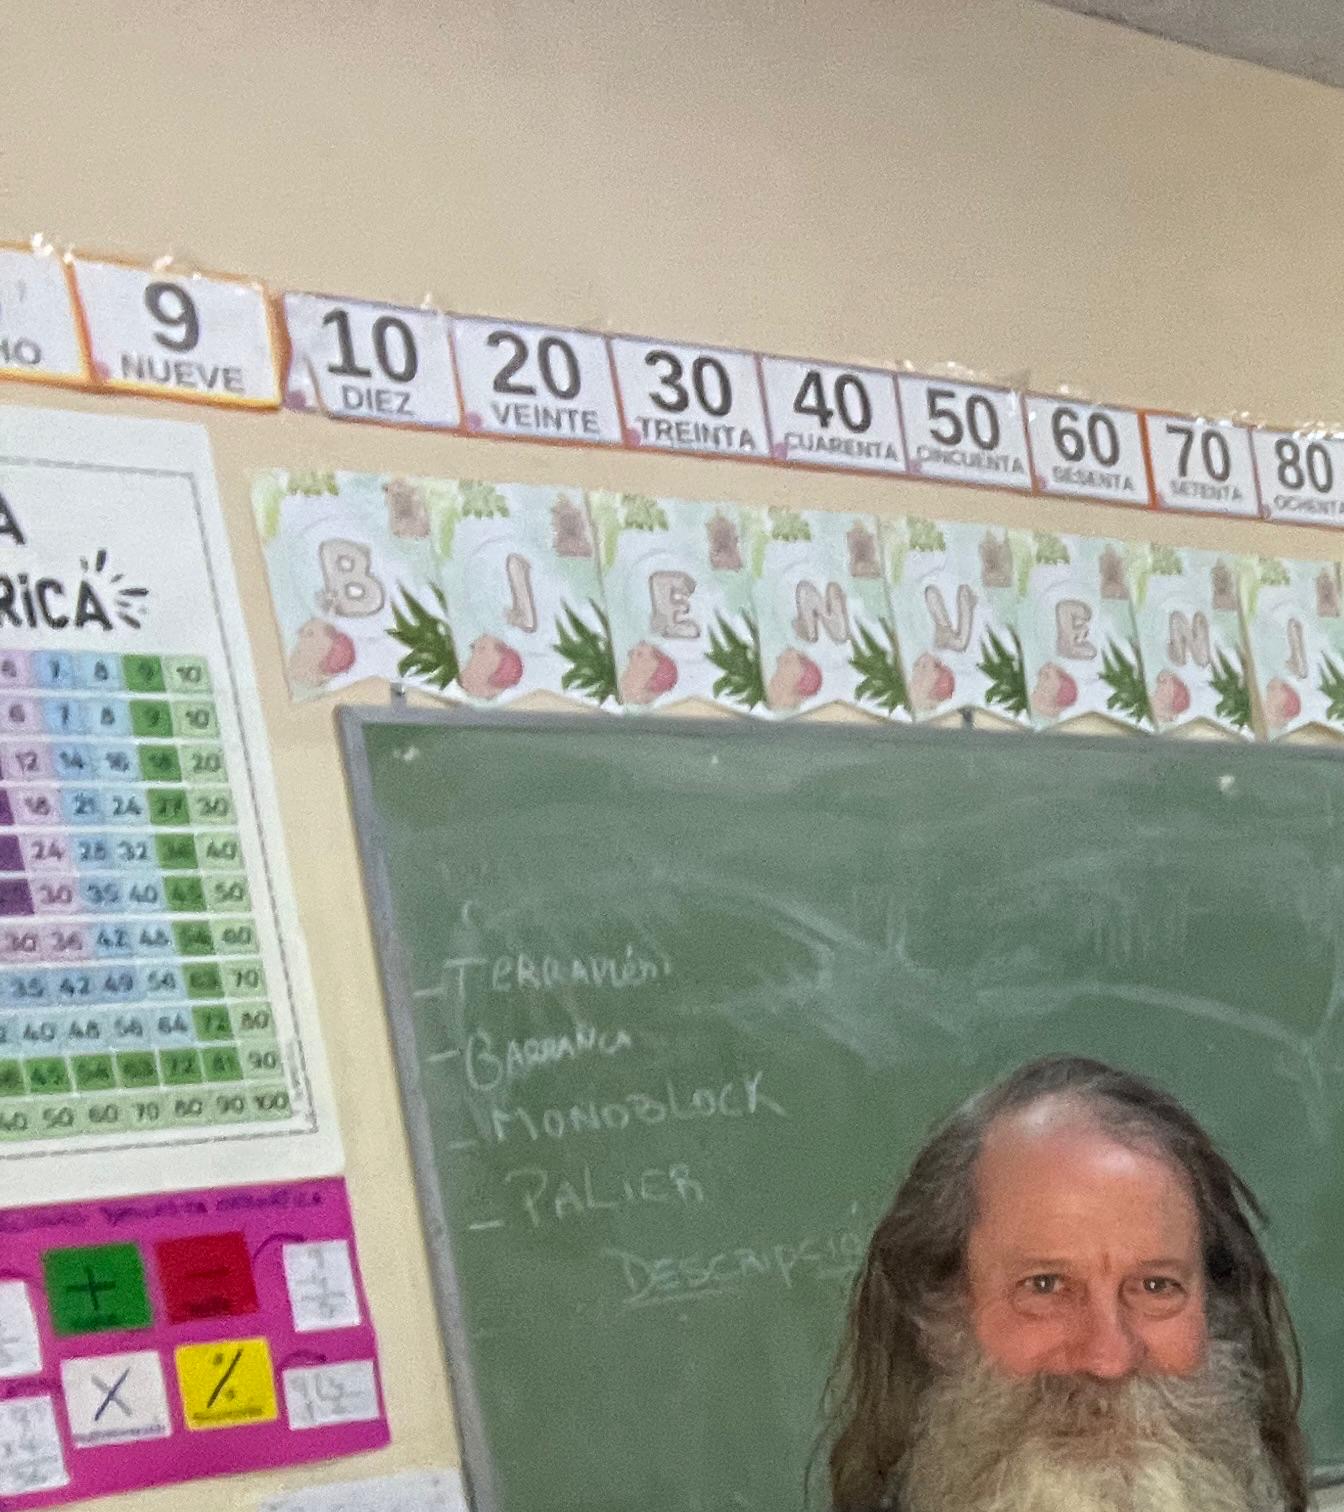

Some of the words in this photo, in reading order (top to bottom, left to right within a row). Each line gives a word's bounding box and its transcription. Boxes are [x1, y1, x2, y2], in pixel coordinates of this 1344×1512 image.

[145, 281, 199, 352] 9
[321, 308, 418, 384] 10
[120, 352, 245, 393] NUEVE
[485, 329, 581, 401] 20
[645, 349, 733, 418] 30
[341, 384, 414, 416] DIEZ
[490, 399, 601, 434] VEINTE
[793, 369, 872, 434] 40
[926, 387, 1001, 451] 50
[637, 415, 757, 450] TREINTA
[783, 431, 899, 461] CUARENTA
[916, 445, 1025, 474] CINCUENTA
[1051, 406, 1120, 467] 60
[1166, 423, 1232, 482] 70
[1274, 437, 1334, 494] 80
[493, 1072, 789, 1143] MONOBLOCK
[505, 1162, 704, 1227] PALIER
